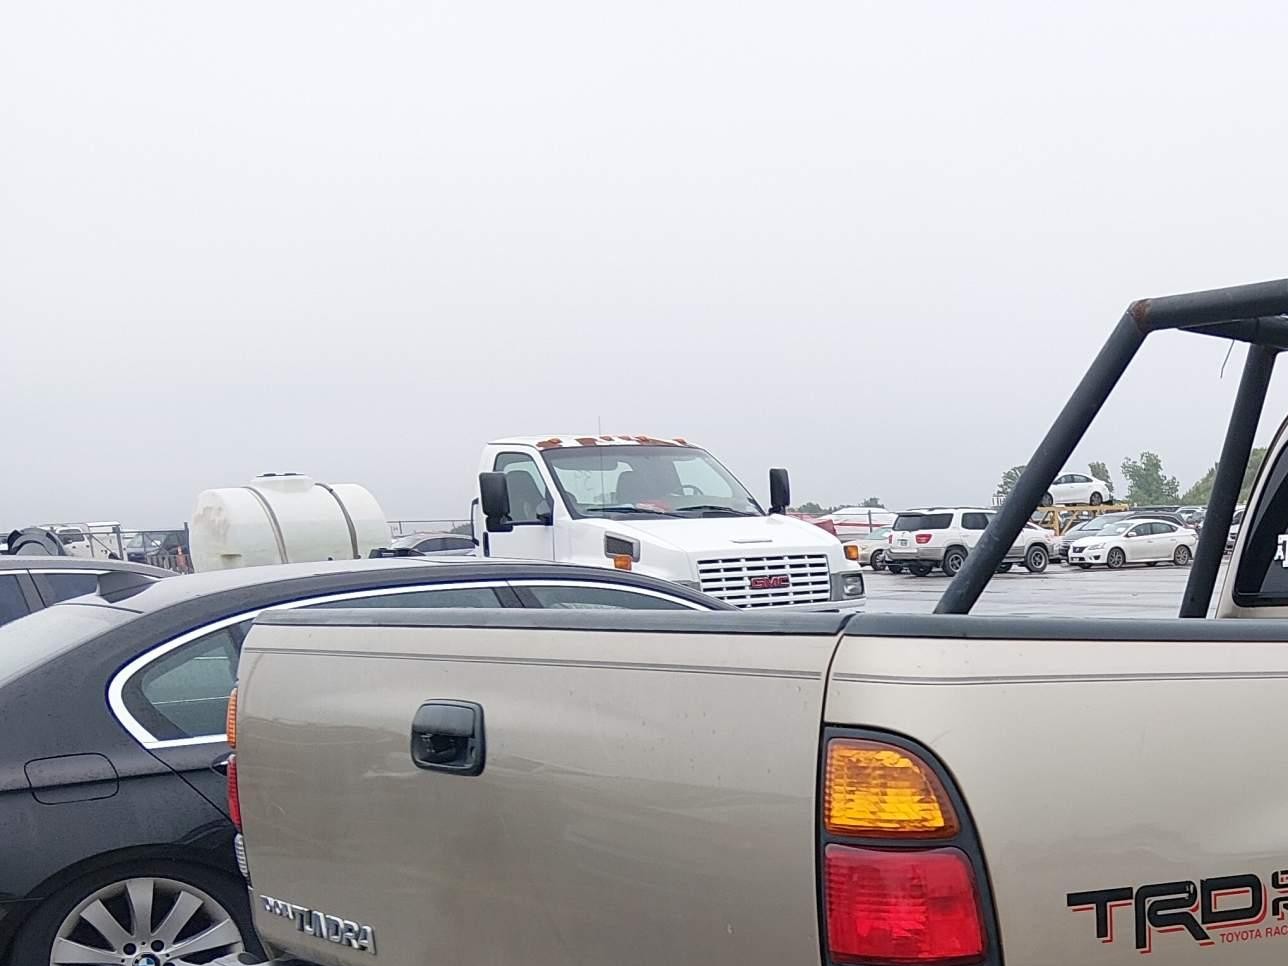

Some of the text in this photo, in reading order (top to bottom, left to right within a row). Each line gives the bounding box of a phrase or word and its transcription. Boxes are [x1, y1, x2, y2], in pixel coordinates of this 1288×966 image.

[751, 575, 790, 589] GMC
[1066, 873, 1267, 953] TRD
[291, 904, 377, 955] TUNDRA
[1219, 930, 1262, 944] TOYOTA
